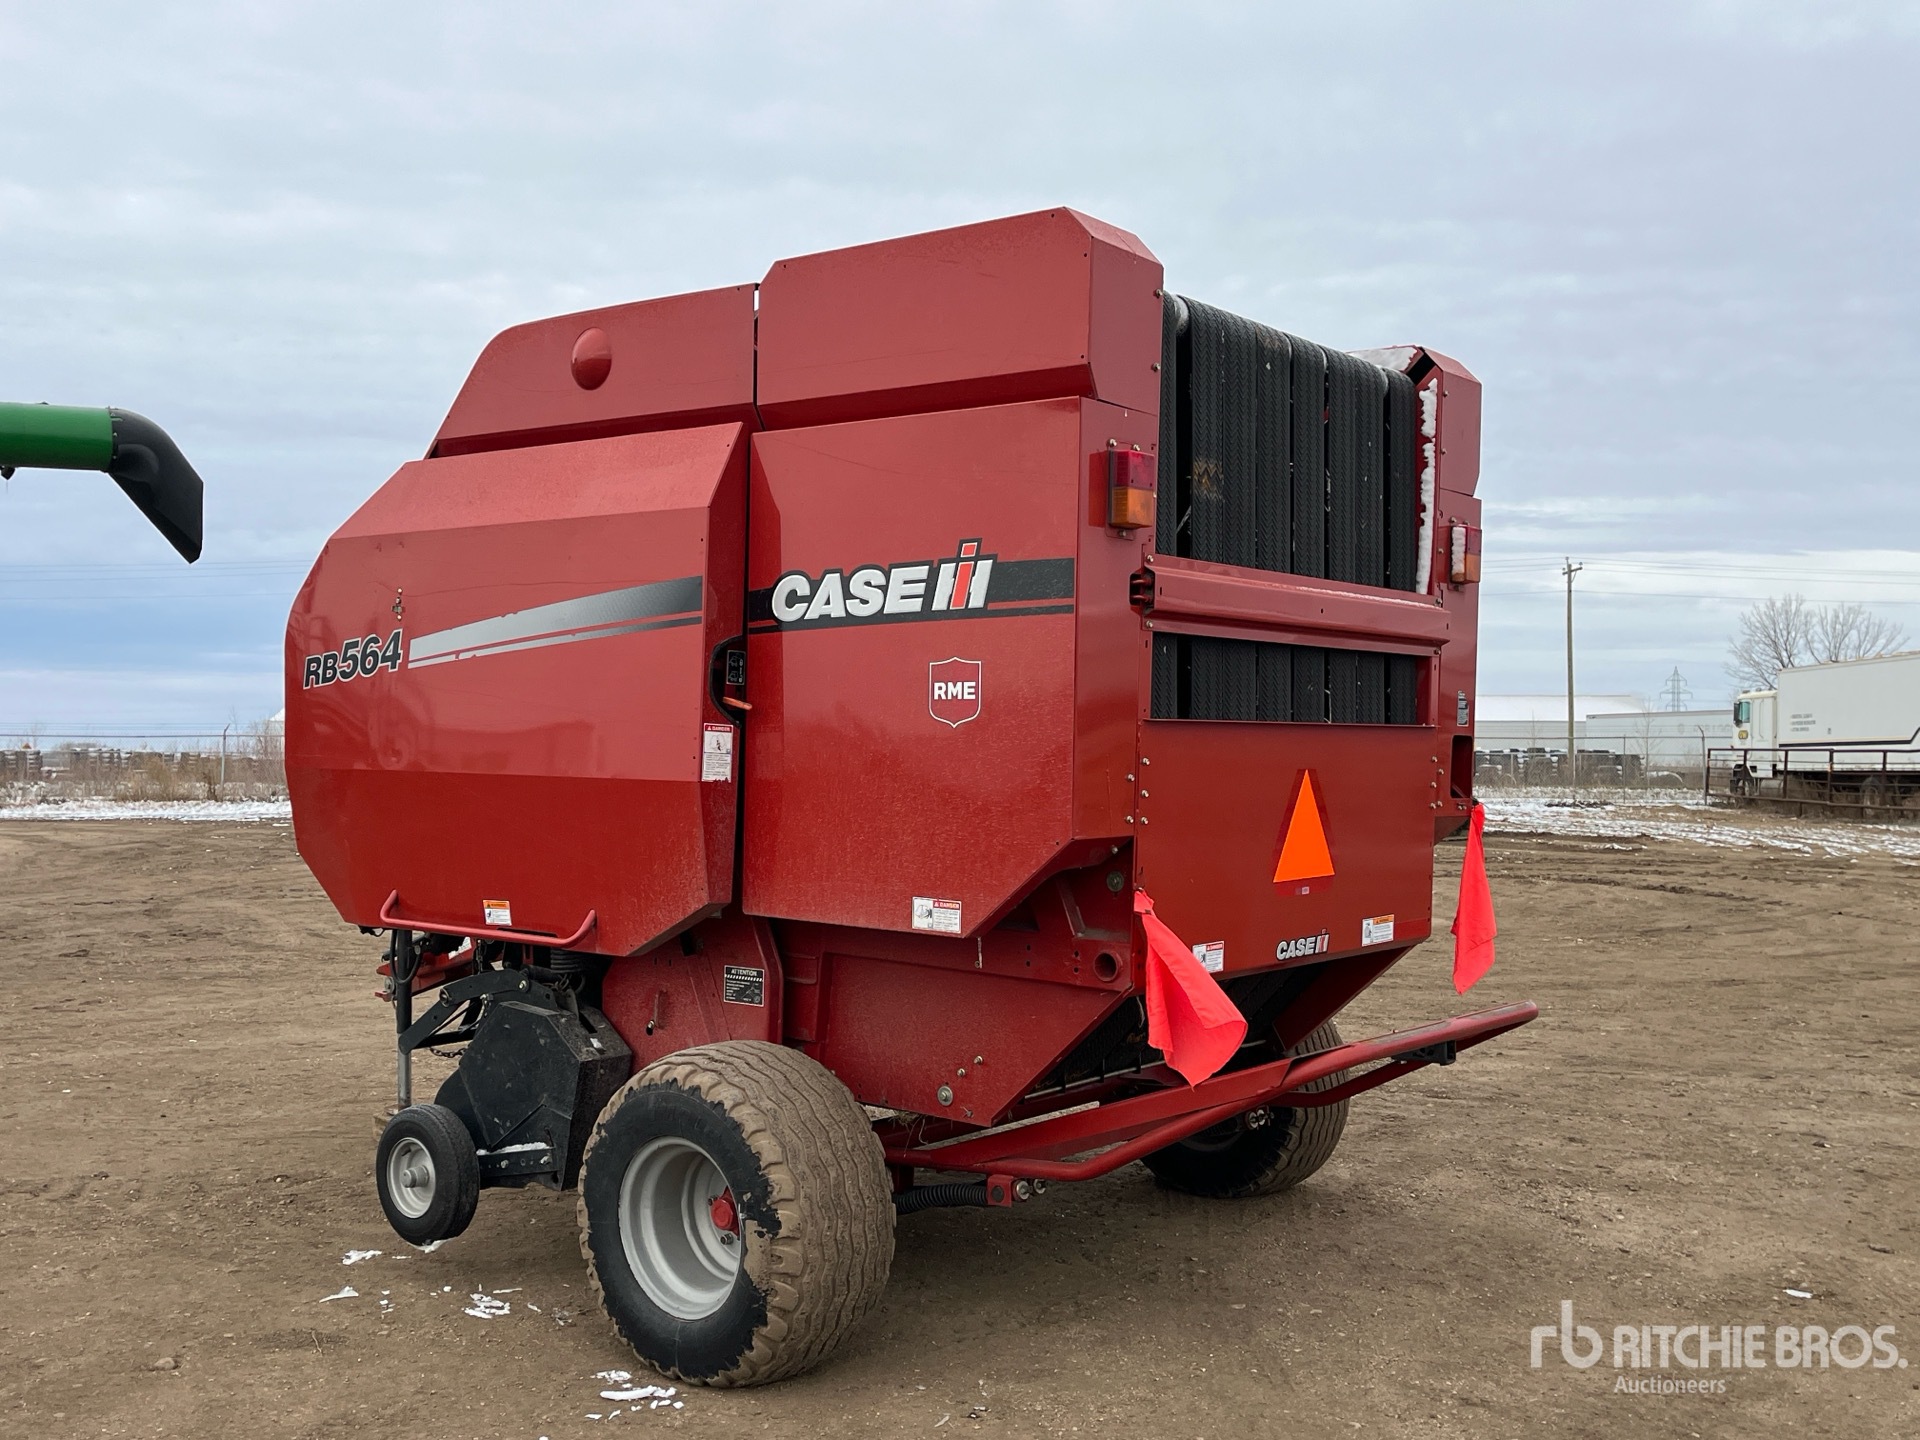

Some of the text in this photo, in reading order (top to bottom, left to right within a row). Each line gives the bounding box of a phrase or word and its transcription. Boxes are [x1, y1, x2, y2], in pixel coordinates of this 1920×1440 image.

[771, 565, 930, 622] CASE
[303, 628, 403, 690] RB564
[933, 681, 976, 700] RME
[1276, 937, 1316, 960] CASE
[730, 968, 758, 977] ATTENTION
